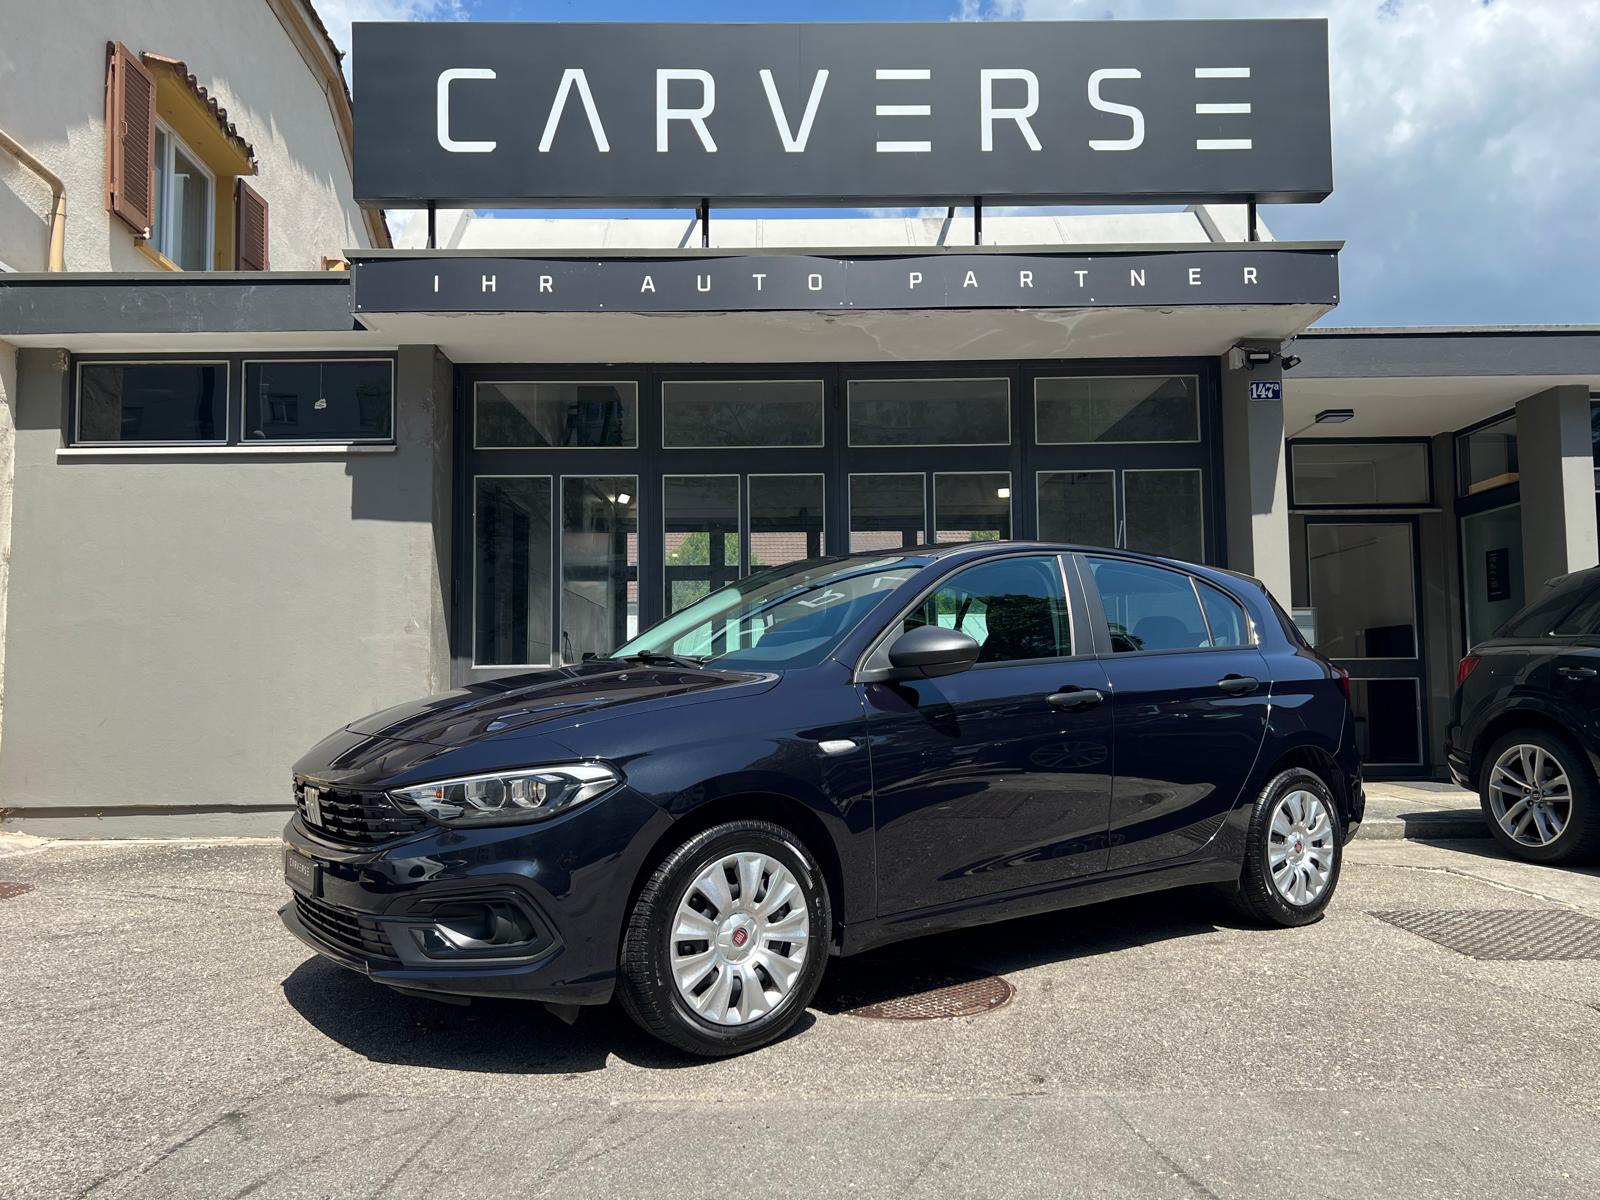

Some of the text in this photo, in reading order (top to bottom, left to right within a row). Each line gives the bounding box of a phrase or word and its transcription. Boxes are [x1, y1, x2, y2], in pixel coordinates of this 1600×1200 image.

[436, 67, 1253, 154] CARVERSE
[433, 266, 1259, 294] IHR AUTO PARTNER
[1250, 383, 1279, 399] 147a
